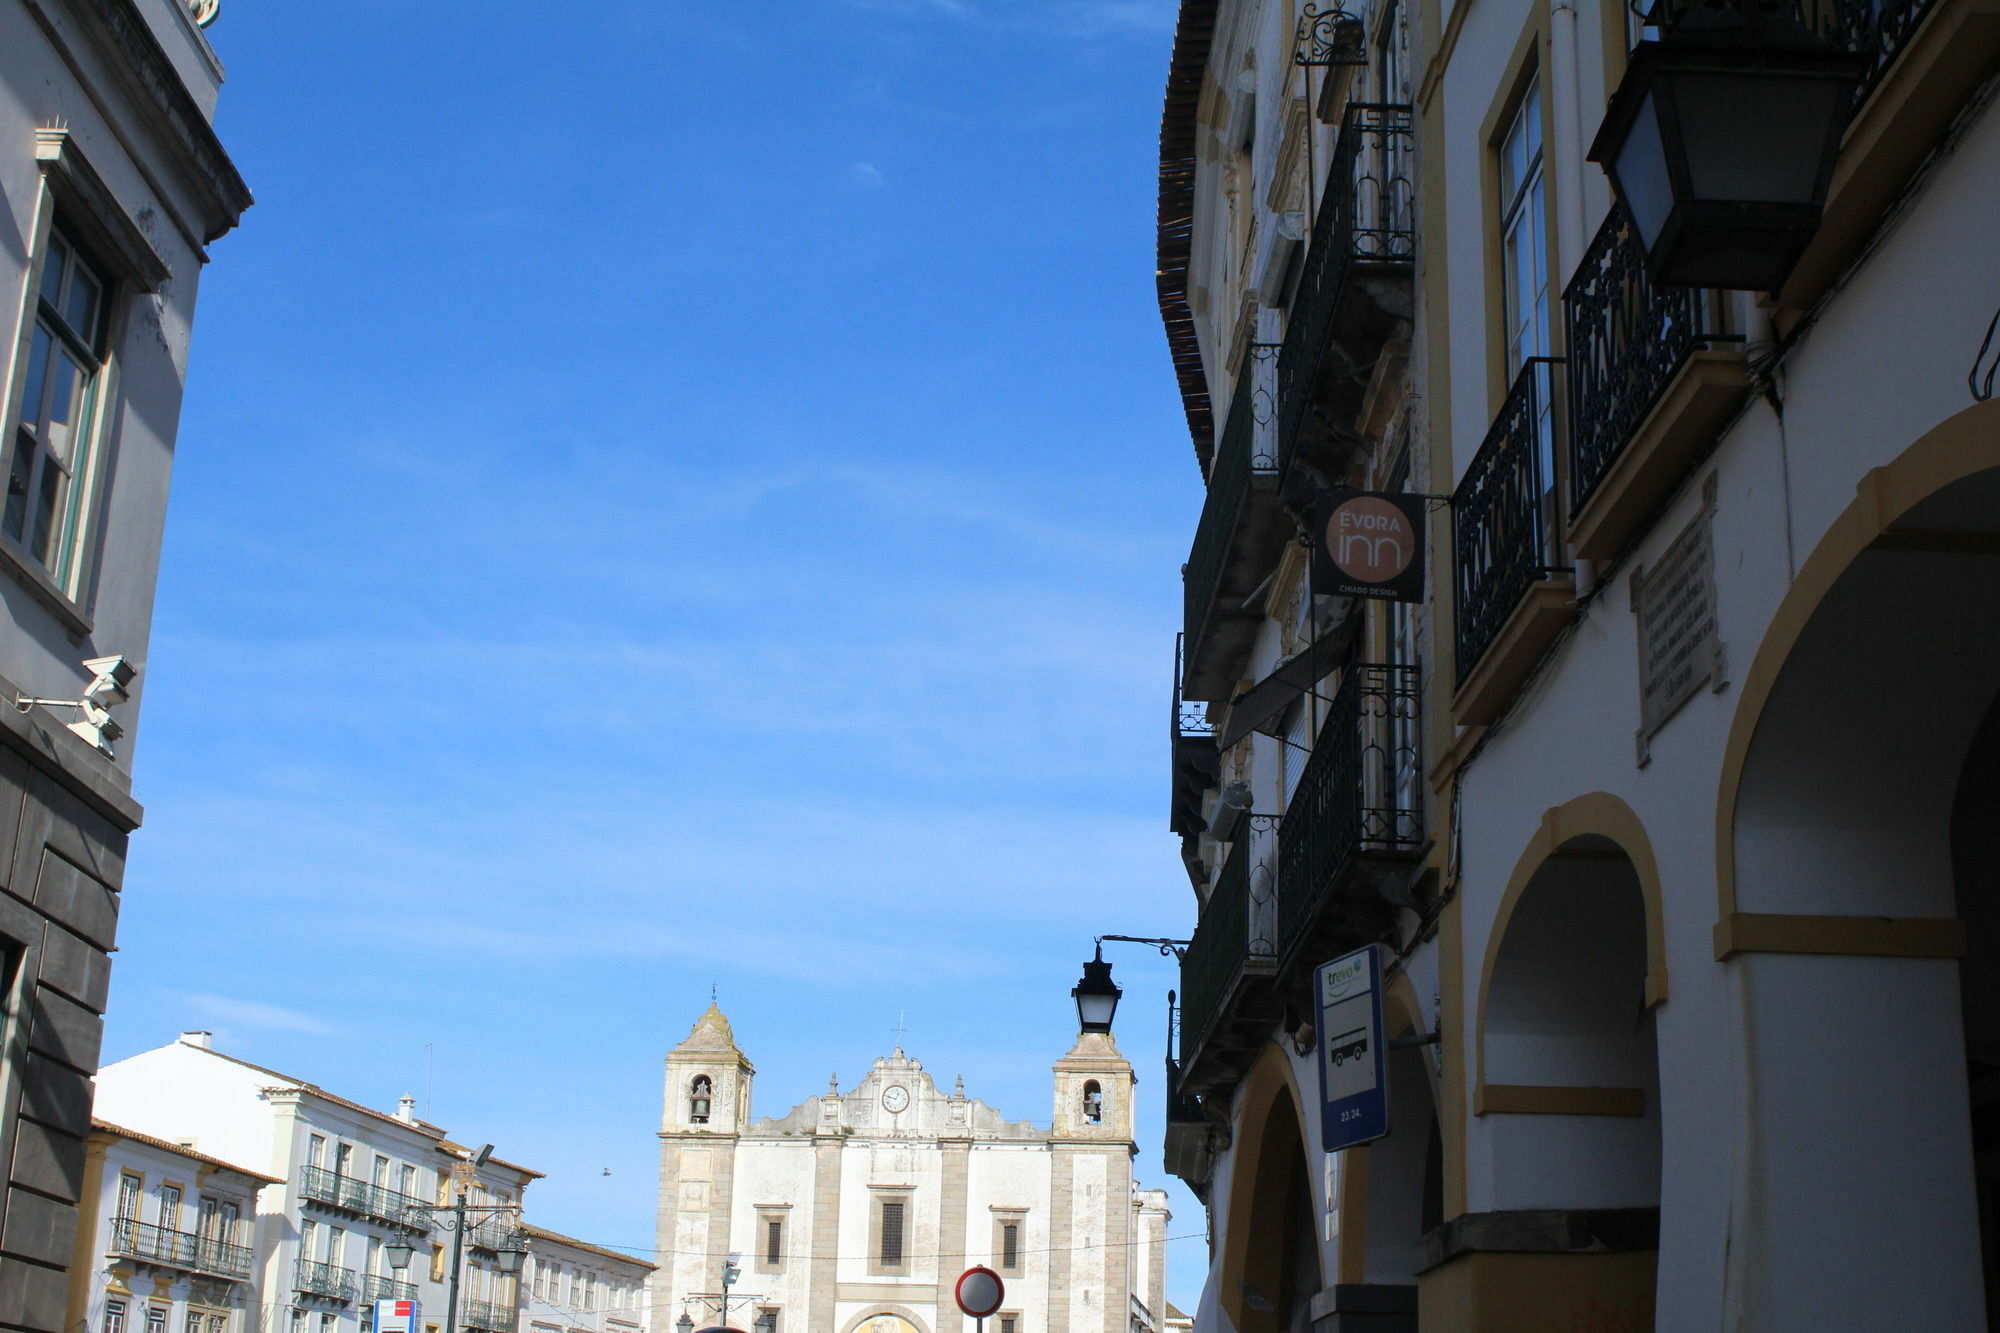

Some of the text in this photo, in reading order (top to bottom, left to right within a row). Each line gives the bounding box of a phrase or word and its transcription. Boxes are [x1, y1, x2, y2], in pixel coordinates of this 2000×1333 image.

[1340, 510, 1400, 532] ÉVORA
[1339, 528, 1400, 569] inn
[1339, 585, 1398, 597] CHIADO DESIGN
[1328, 967, 1353, 985] trevo
